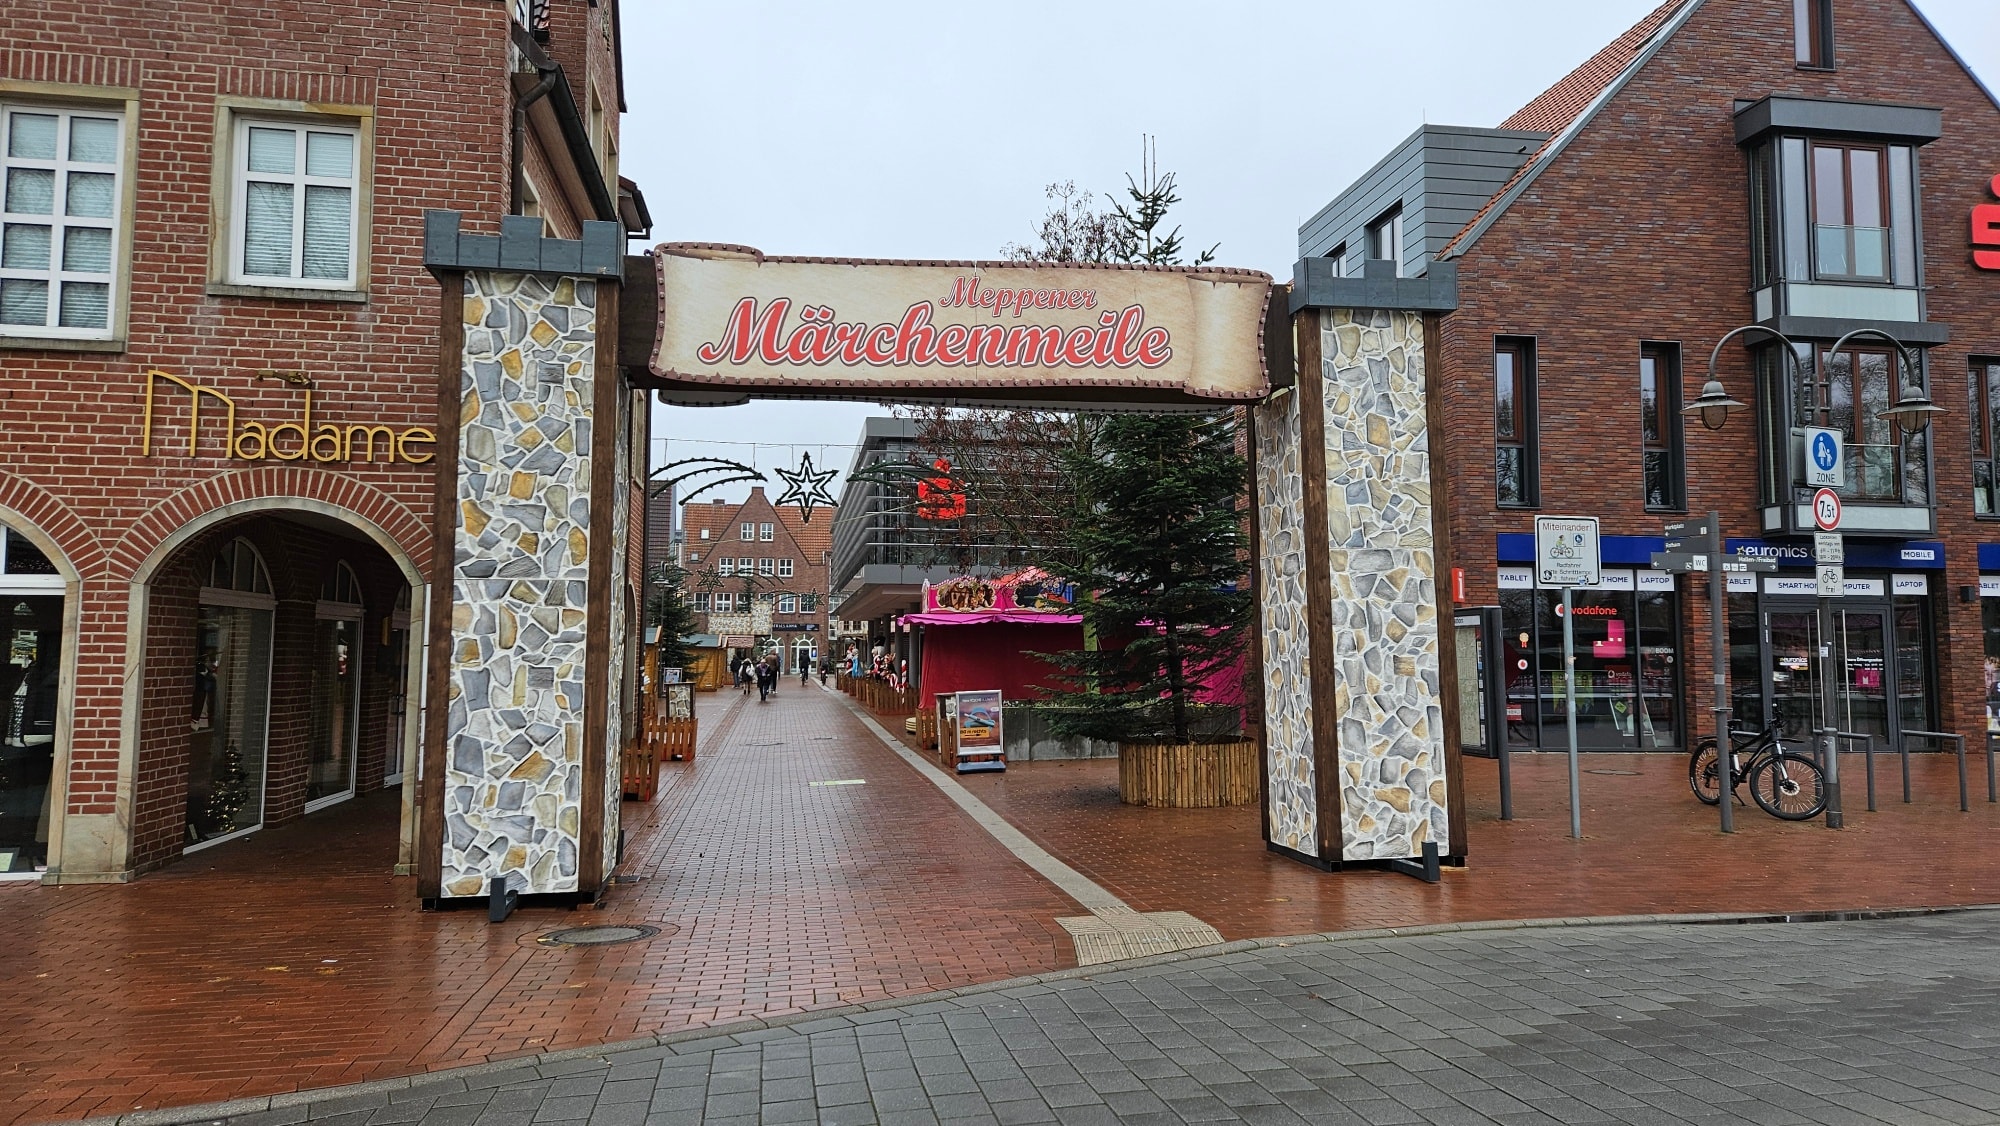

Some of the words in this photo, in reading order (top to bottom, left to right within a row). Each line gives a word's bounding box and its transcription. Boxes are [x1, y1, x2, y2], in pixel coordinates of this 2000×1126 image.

[939, 276, 1097, 316] Meppener
[697, 297, 1172, 369] Märchenmeile
[144, 370, 437, 463] Madame
[1816, 473, 1835, 483] ZONE
[1819, 501, 1835, 518] 7,5t
[1542, 522, 1592, 531] Miteinander!
[1745, 544, 1808, 558] euronics
[1695, 557, 1706, 566] WC
[1825, 585, 1836, 593] frei
[1571, 605, 1618, 615] vodafone
